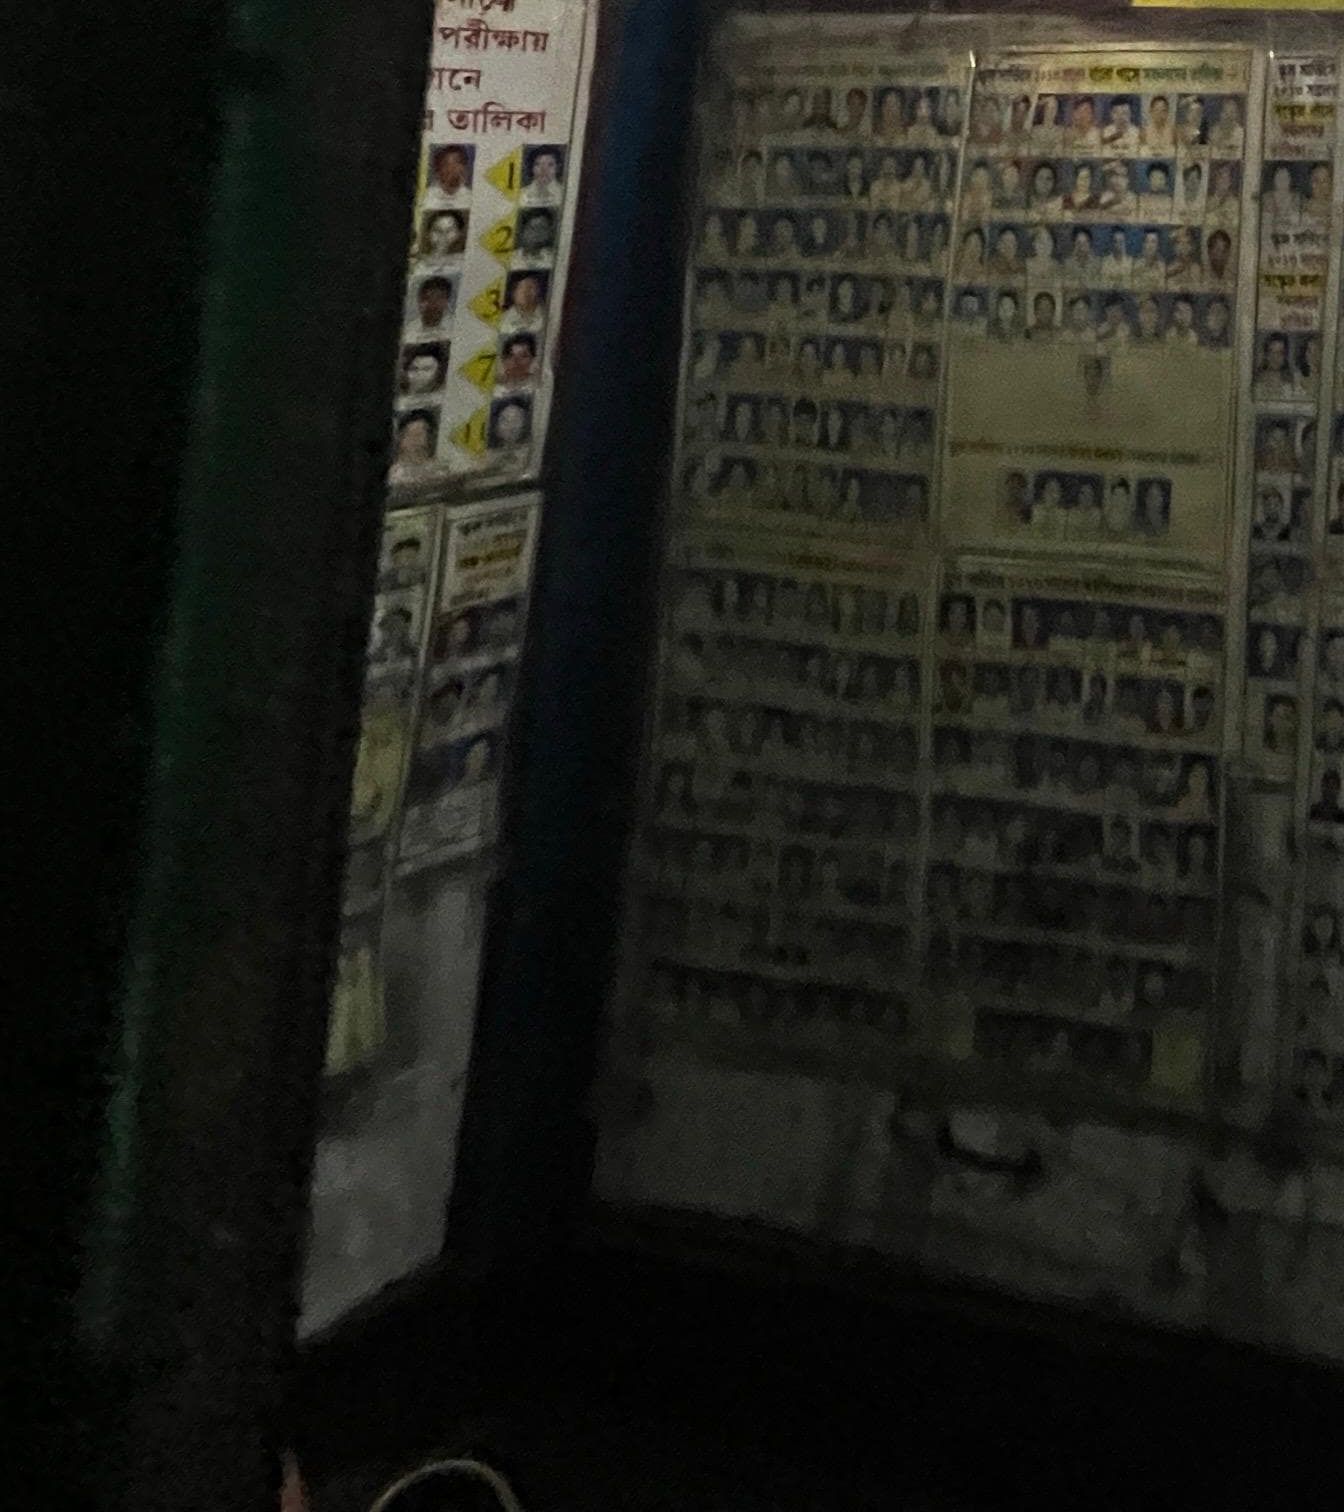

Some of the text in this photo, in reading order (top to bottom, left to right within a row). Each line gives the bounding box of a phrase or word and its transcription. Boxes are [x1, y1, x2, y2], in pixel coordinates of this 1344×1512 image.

[438, 18, 550, 52] পরীক্ষায়
[431, 68, 482, 91] ানে
[447, 101, 547, 134] তালিকা
[493, 224, 514, 254] 2
[482, 288, 501, 319] 3
[479, 353, 498, 382] 7
